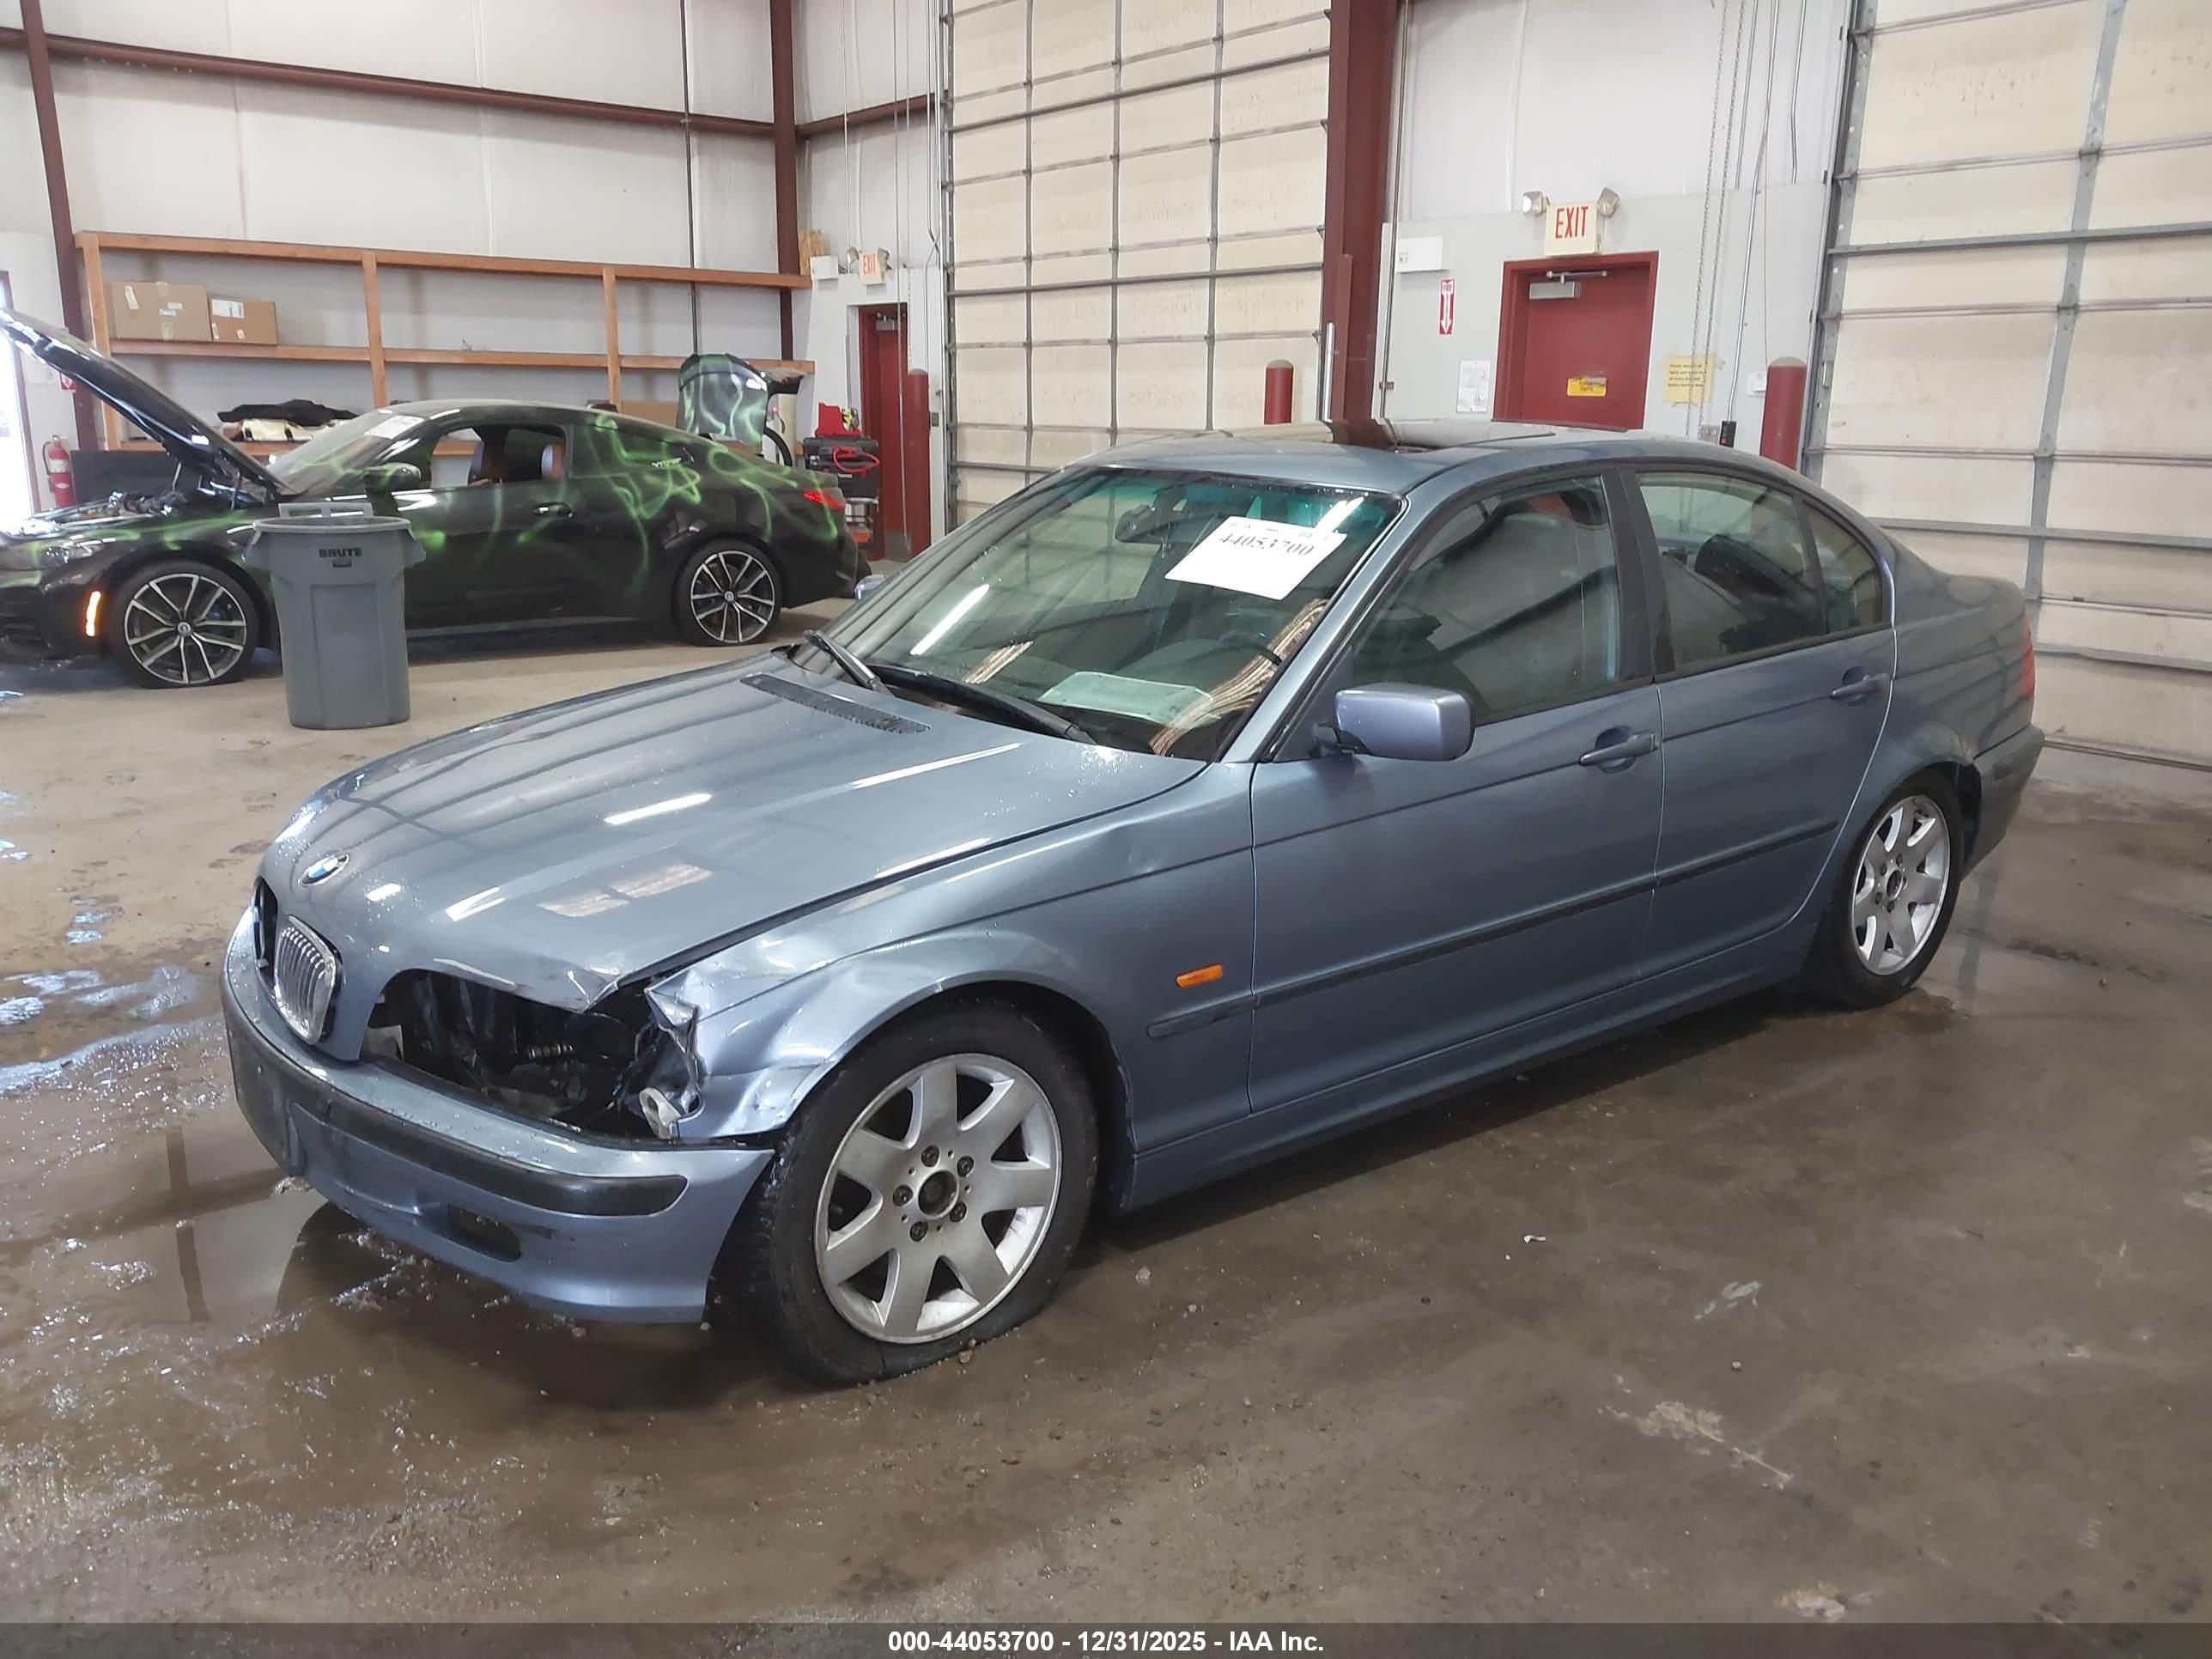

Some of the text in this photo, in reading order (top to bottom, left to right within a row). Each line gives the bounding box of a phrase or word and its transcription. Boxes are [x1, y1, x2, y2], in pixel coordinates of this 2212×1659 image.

[1555, 206, 1589, 239] EXIT
[862, 253, 876, 275] EXIT
[319, 547, 362, 558] BRUTE
[1219, 533, 1315, 556] 44053700
